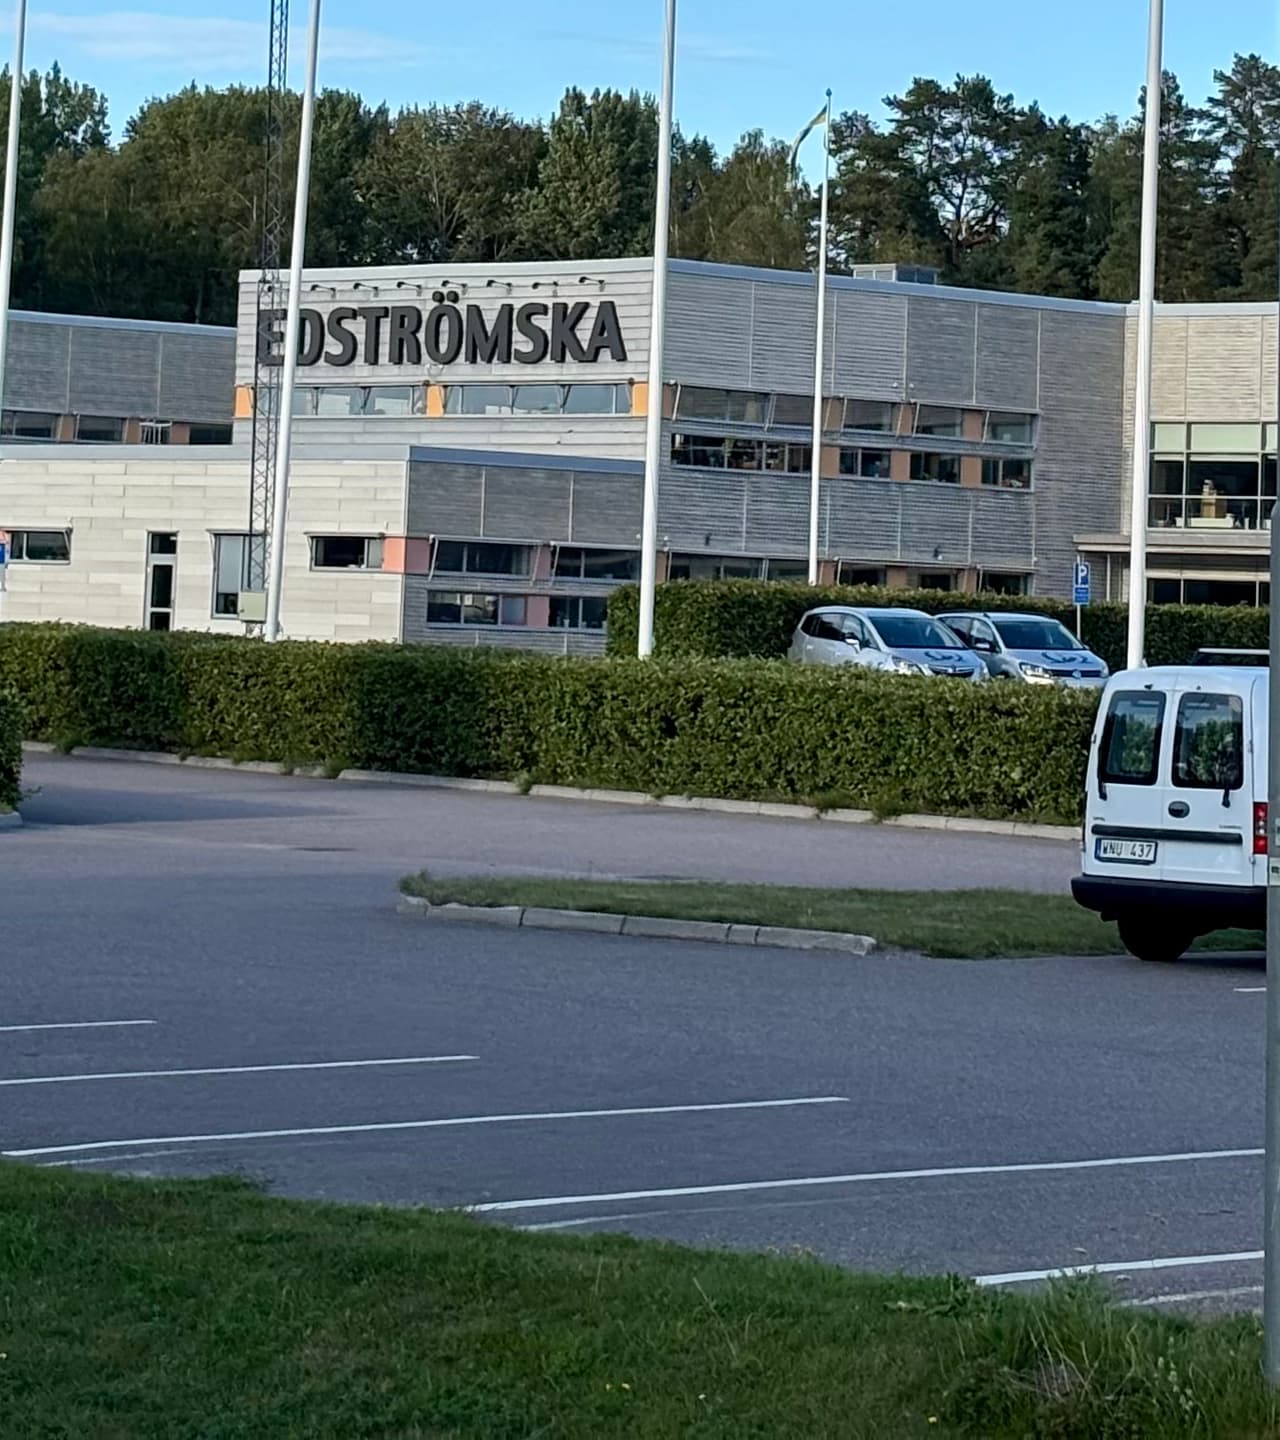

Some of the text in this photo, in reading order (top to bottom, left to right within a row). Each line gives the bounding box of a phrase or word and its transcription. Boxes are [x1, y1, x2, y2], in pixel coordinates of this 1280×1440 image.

[258, 289, 628, 367] EDSTRÖMSKA
[1078, 565, 1088, 585] P
[1102, 841, 1153, 858] WNU 437
